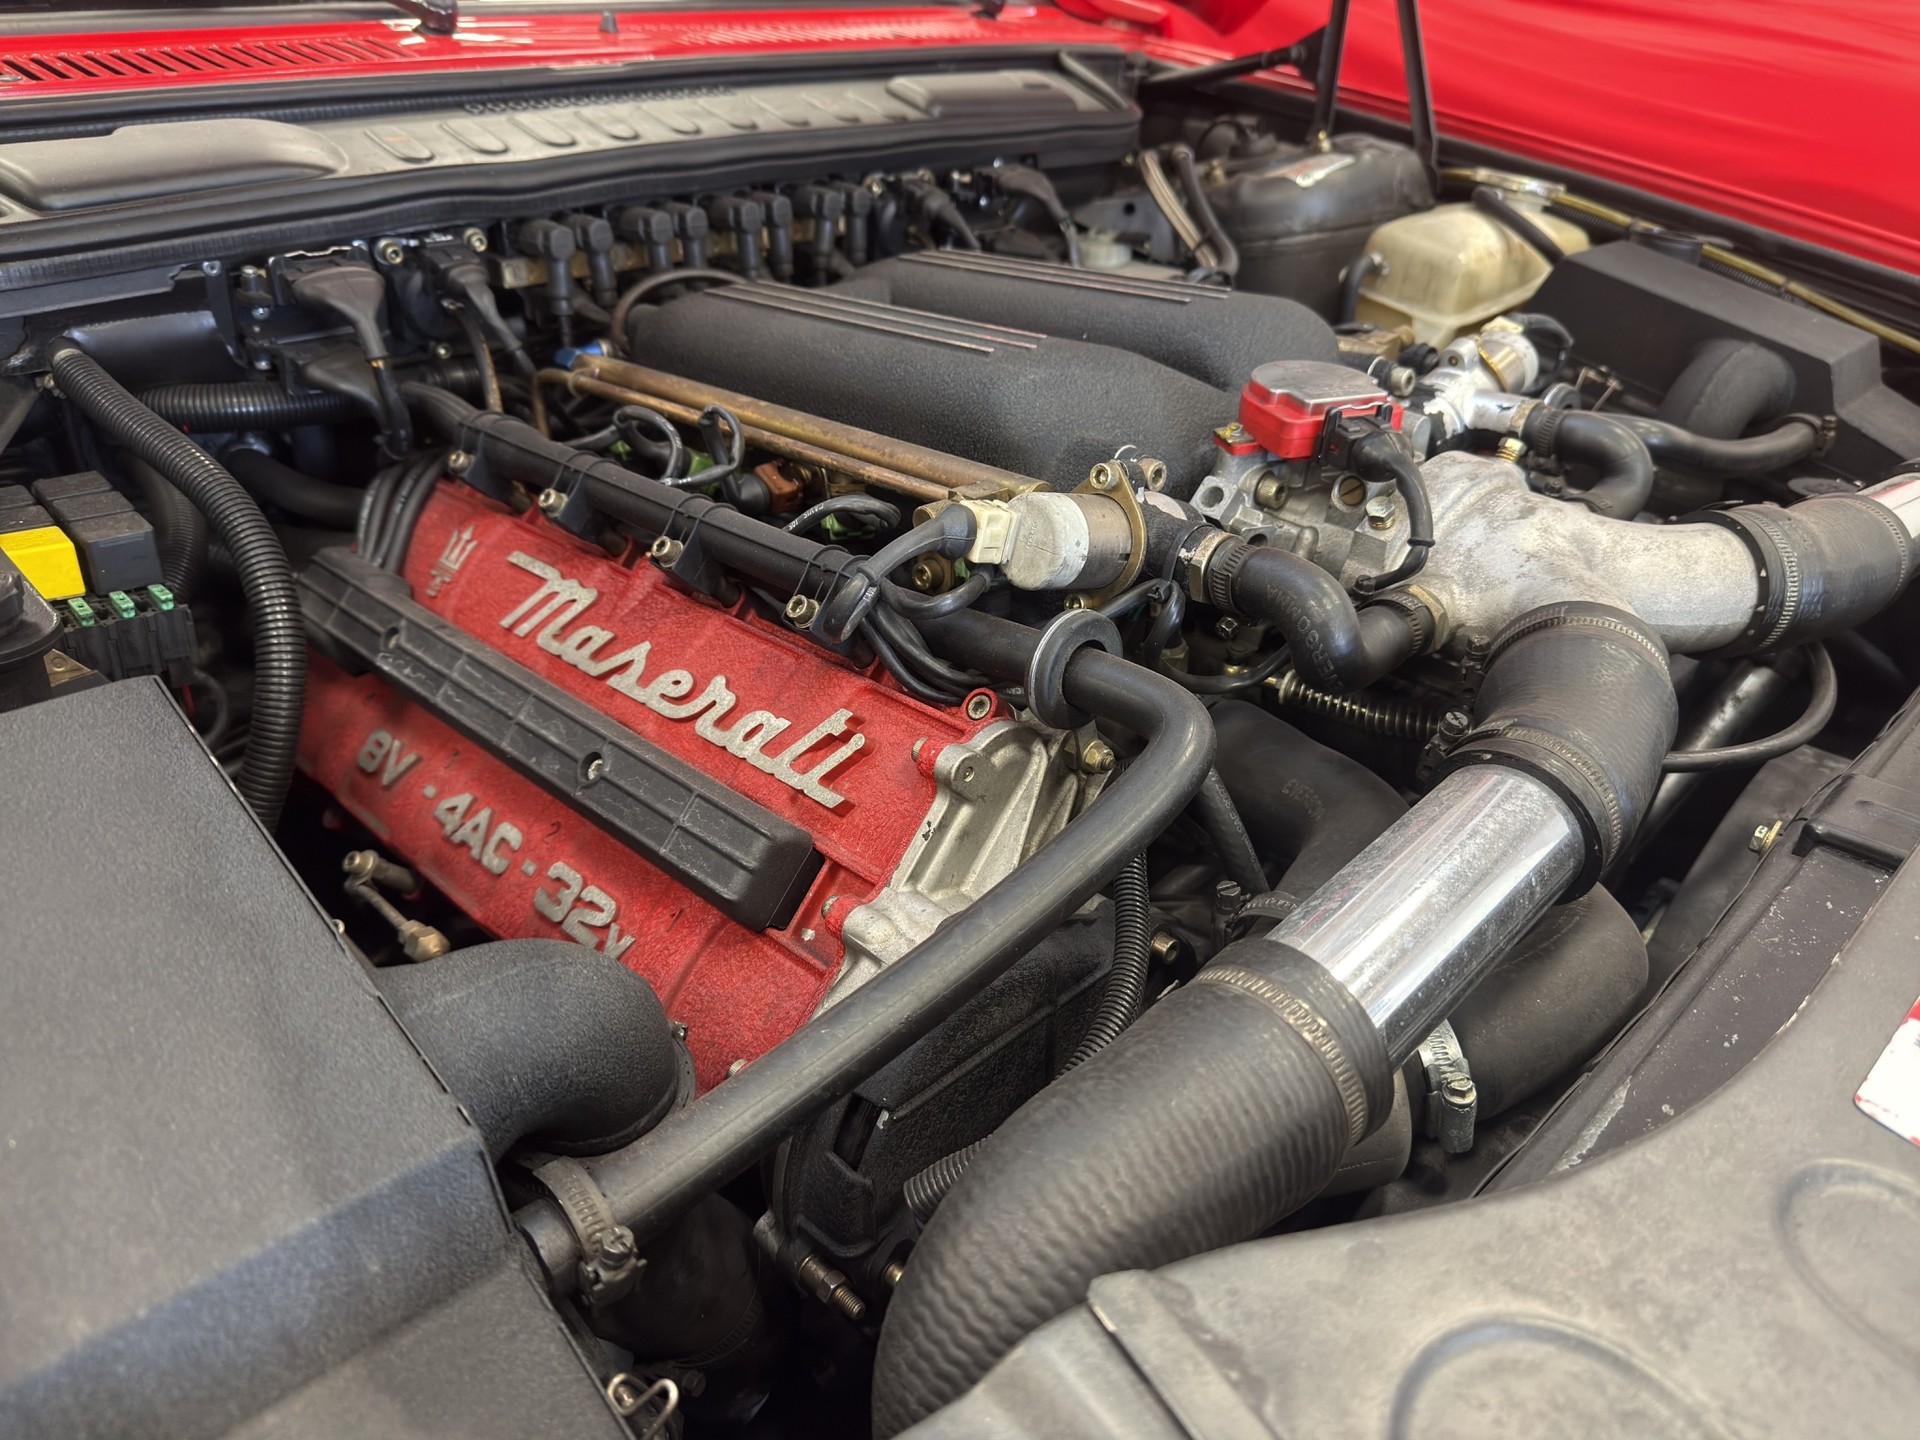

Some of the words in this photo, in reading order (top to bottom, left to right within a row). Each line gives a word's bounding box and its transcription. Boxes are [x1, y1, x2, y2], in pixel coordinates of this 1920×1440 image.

[499, 550, 865, 809] Maserati
[358, 727, 418, 786] 8V
[434, 791, 523, 875] 4AC
